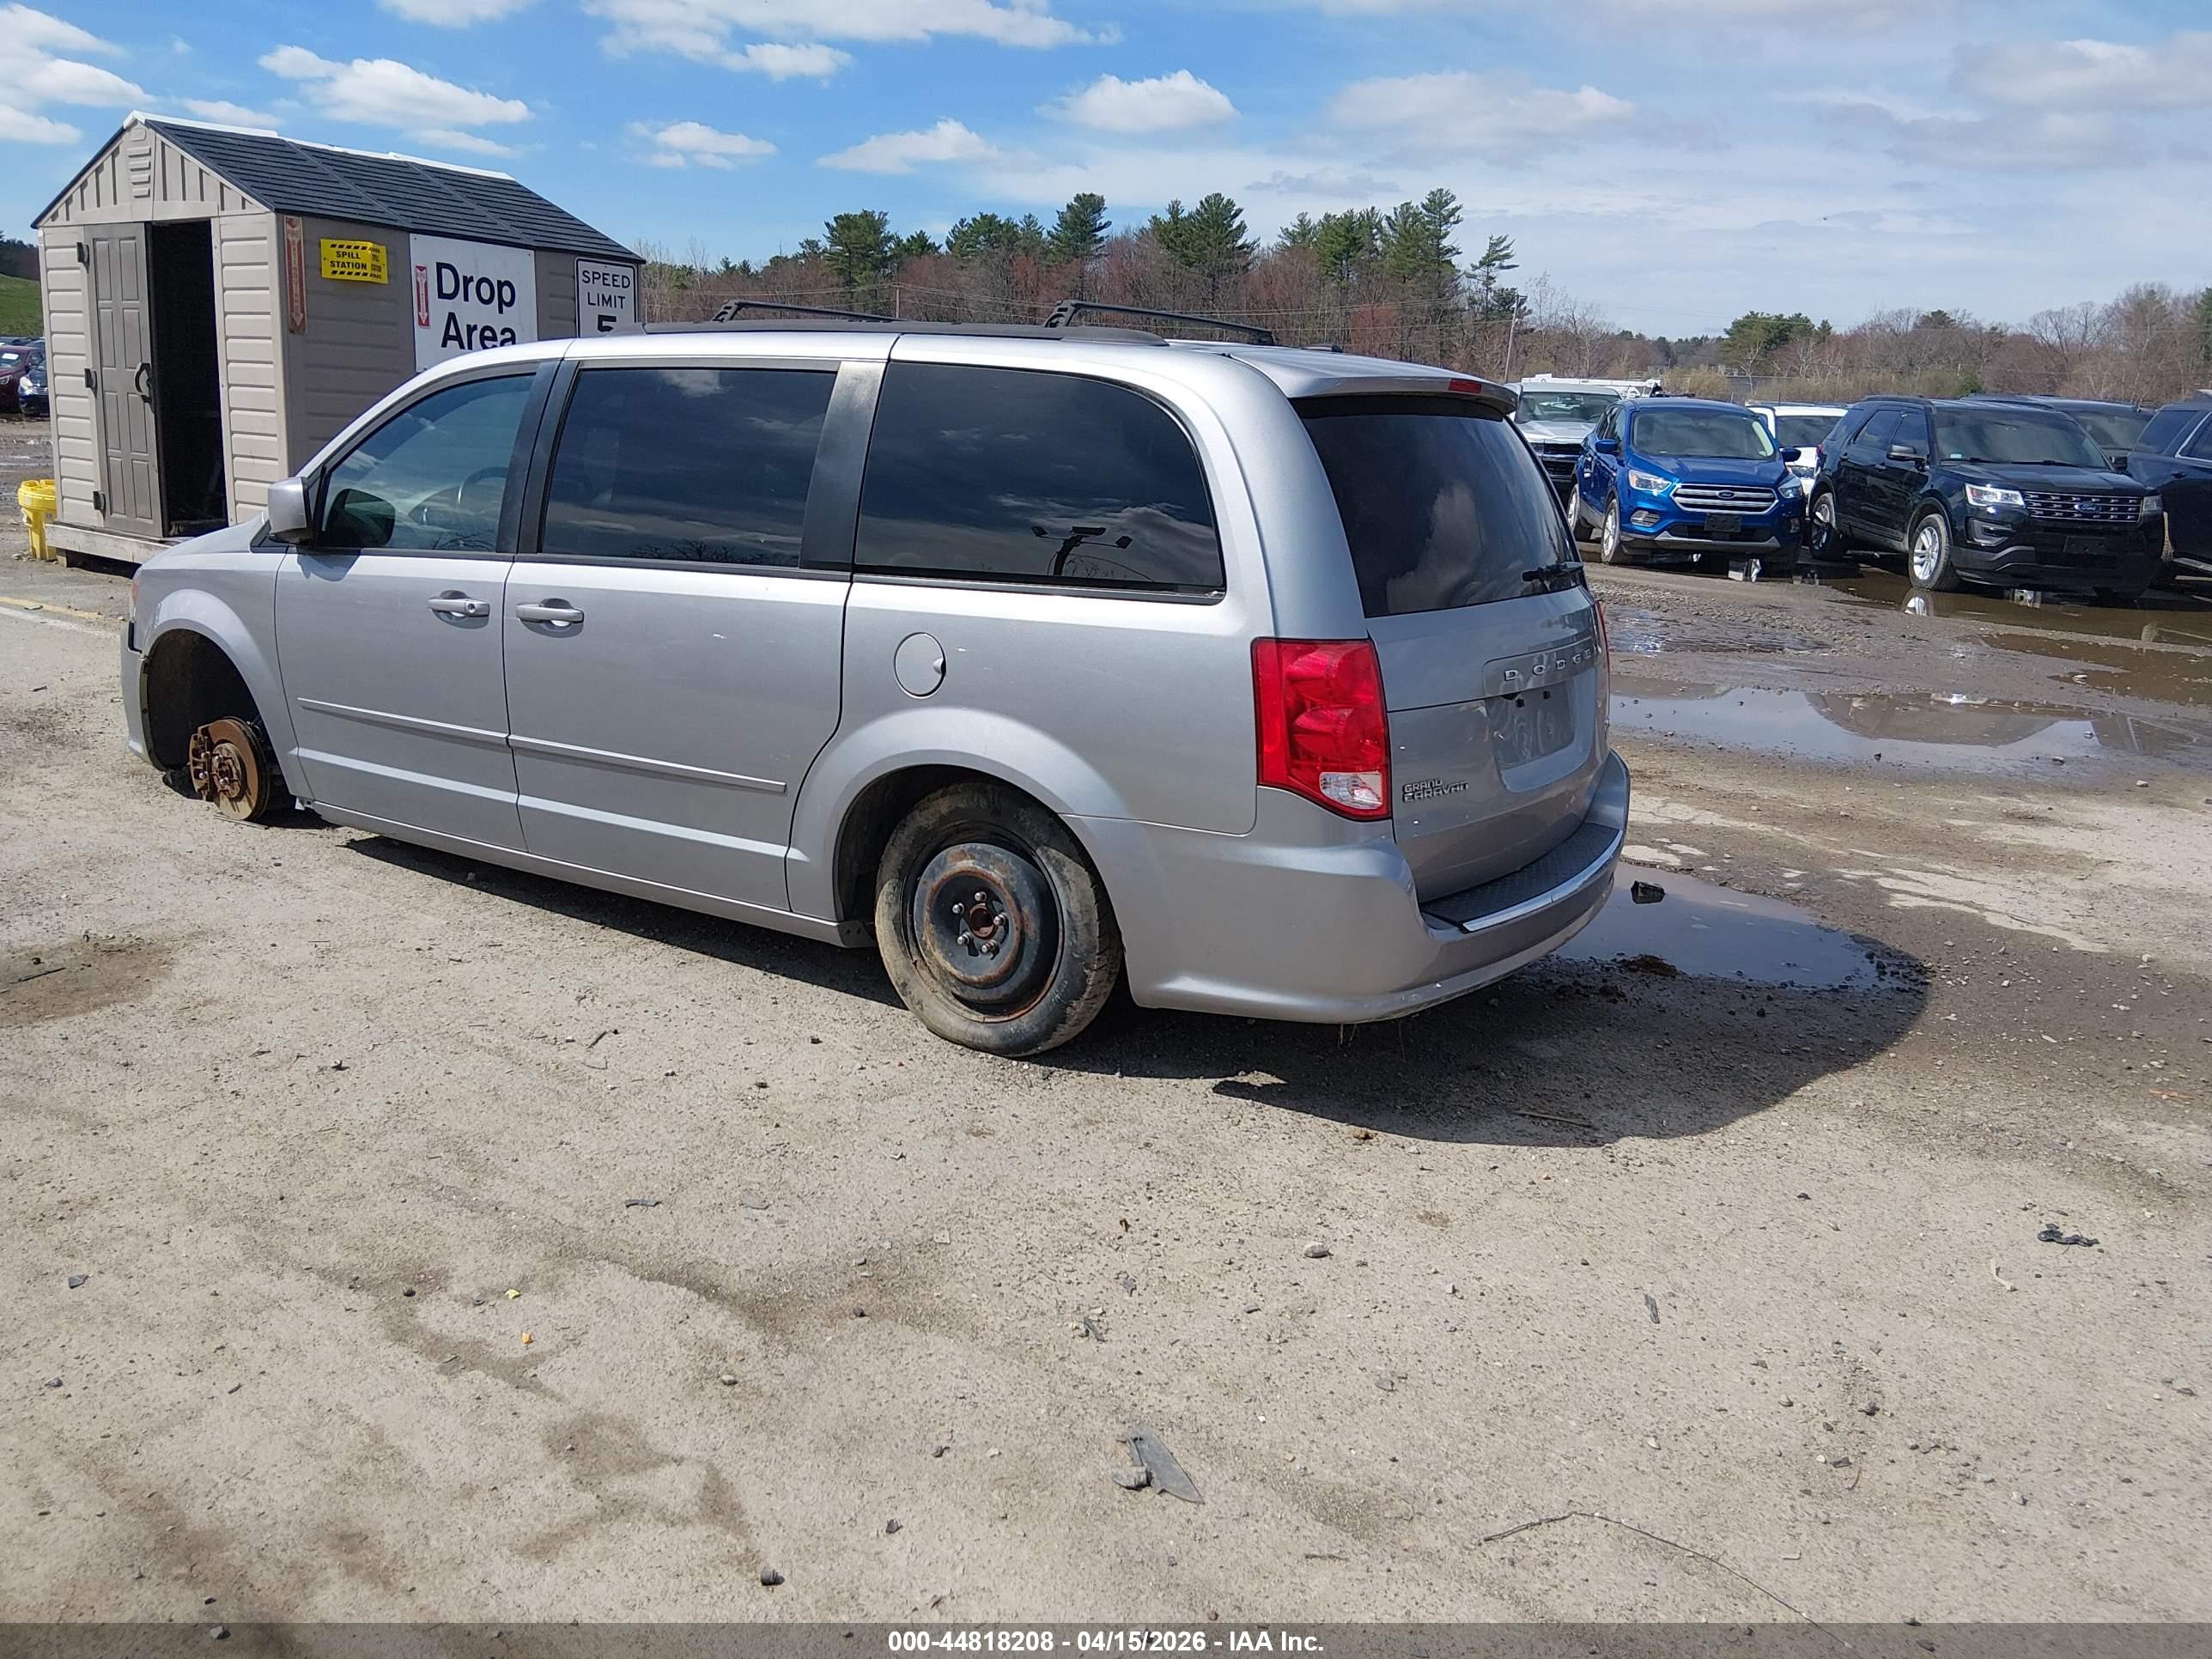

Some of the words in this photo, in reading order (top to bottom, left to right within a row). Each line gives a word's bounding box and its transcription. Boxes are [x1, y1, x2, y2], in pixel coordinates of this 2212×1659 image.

[336, 251, 361, 259] SPILL
[330, 260, 368, 270] STATION
[435, 262, 516, 314] Drop
[581, 270, 631, 289] SPEED
[587, 292, 626, 309] LIMIT
[441, 312, 516, 350] Area
[1504, 648, 1591, 681] DODGE
[1402, 779, 1443, 793] GRAND
[1402, 781, 1469, 803] CARAVAN
